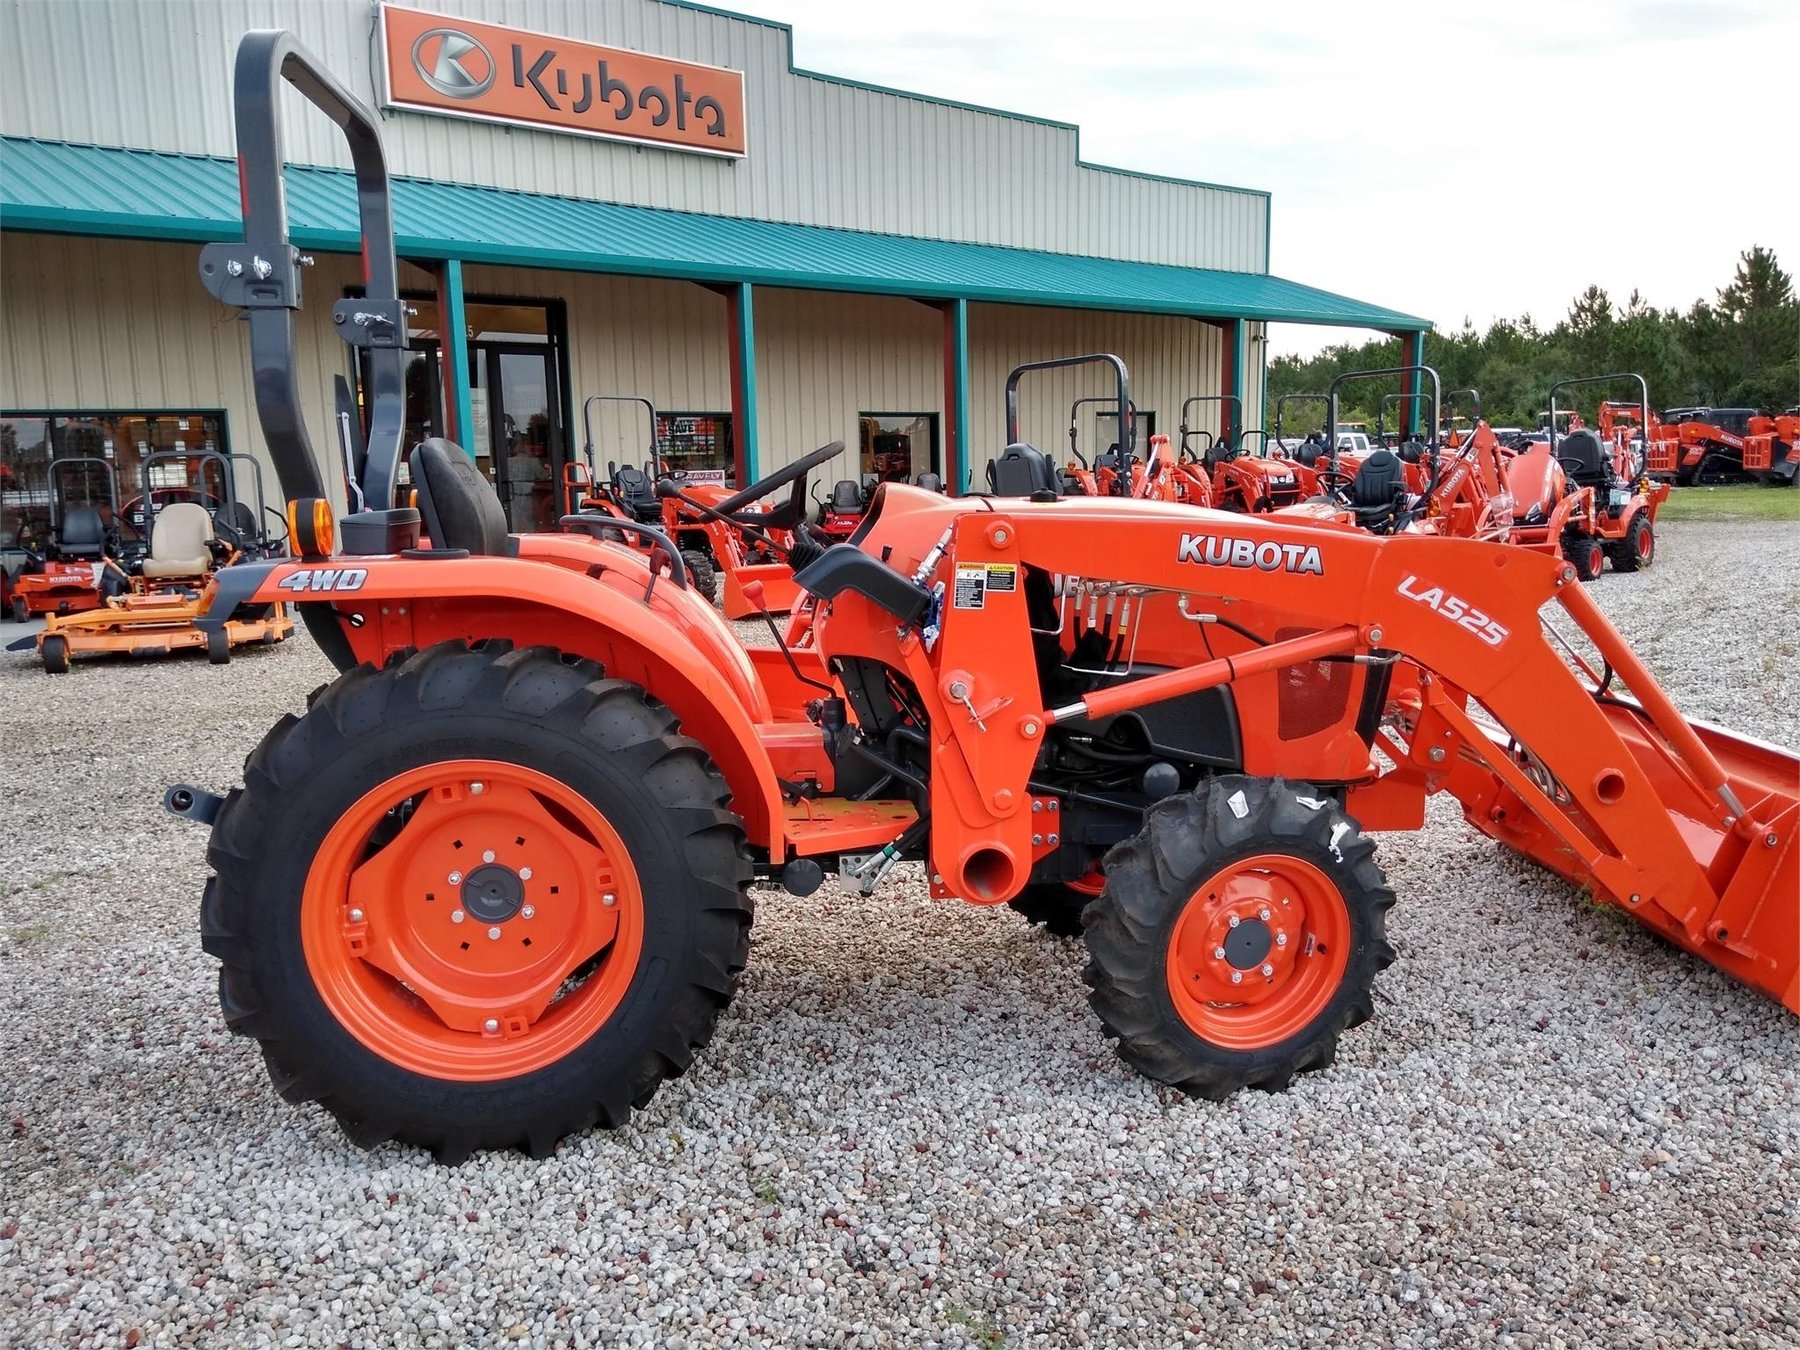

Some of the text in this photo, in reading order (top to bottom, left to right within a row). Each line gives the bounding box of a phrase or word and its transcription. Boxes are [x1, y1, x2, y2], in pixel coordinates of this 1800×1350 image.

[511, 44, 726, 137] Kubota
[668, 423, 695, 435] SAVE
[1721, 433, 1744, 447] KUBOTA
[680, 472, 722, 480] RAVELY
[1440, 468, 1465, 498] KUBOTA
[1178, 533, 1325, 576] KUBOTA
[49, 575, 83, 583] KUBOTA
[278, 568, 368, 592] 4WD
[1397, 574, 1509, 646] LA525
